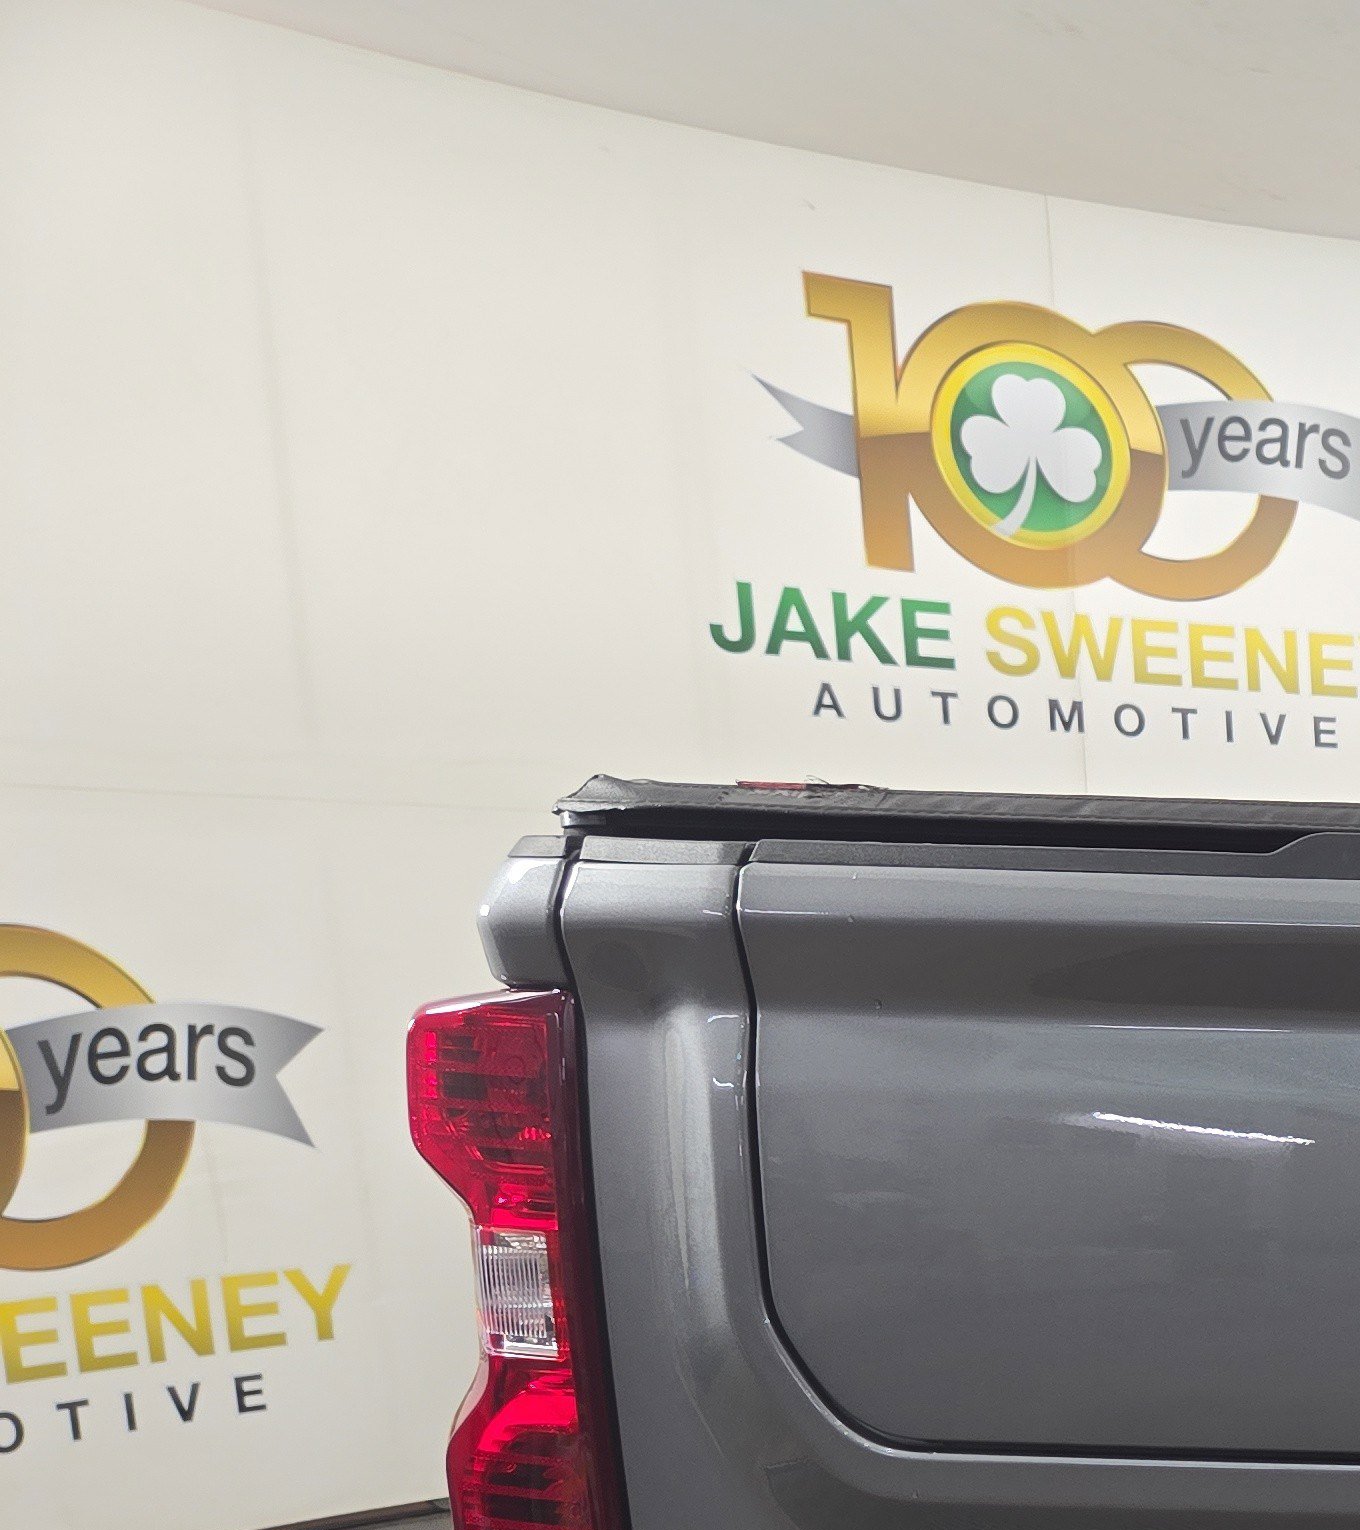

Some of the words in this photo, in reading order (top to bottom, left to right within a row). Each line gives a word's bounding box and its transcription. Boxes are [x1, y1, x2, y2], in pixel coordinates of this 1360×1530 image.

[1179, 412, 1352, 480] years
[709, 581, 957, 671] JAKE
[812, 682, 1339, 749] AUTOMOTIVE
[38, 1020, 256, 1114] years
